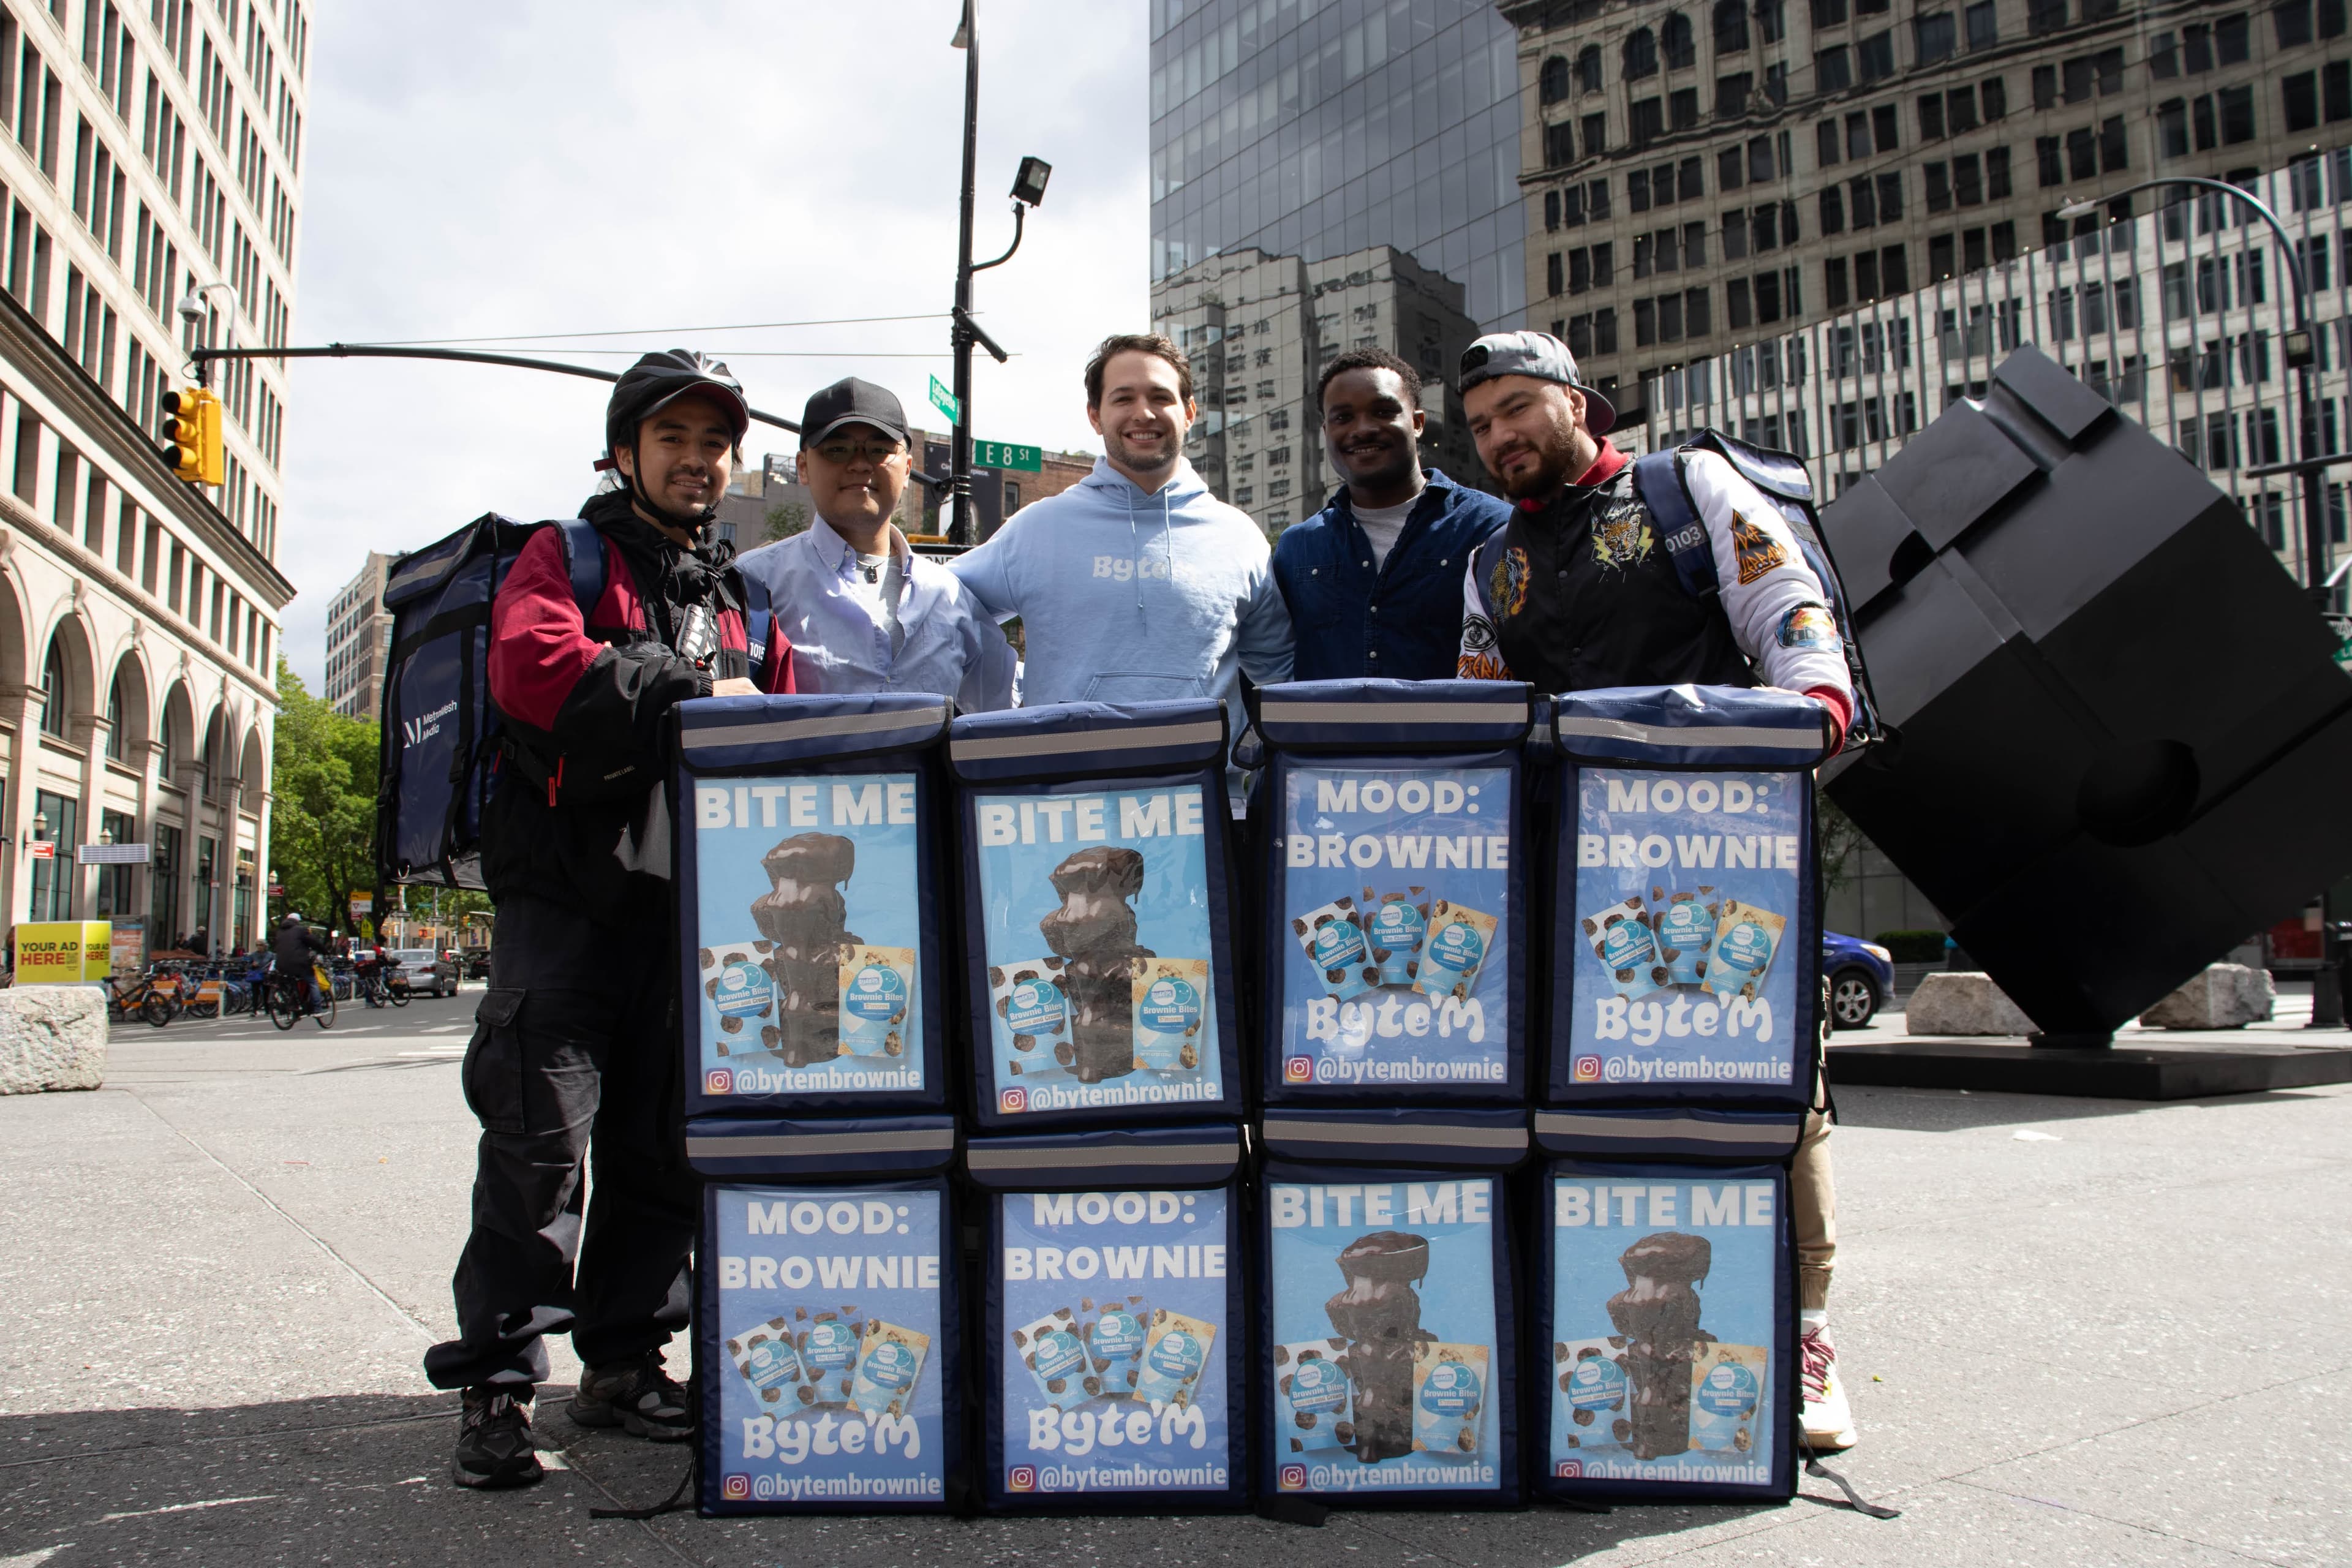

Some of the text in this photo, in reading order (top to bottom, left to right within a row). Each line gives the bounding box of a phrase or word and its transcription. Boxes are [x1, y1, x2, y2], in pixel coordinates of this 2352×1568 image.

[987, 445, 1029, 466] E 8 St
[1665, 526, 1701, 551] 0103
[750, 642, 765, 661] 1015
[696, 783, 916, 829] BITE ME
[1317, 780, 1480, 814] MOOD:
[1607, 780, 1768, 813] MOOD:
[980, 793, 1204, 846] BITE ME
[1287, 835, 1509, 869] BROWNIE
[1578, 835, 1798, 869] BROWNIE
[21, 941, 78, 952] YOUR AD
[21, 953, 65, 965] HERE
[86, 951, 104, 960] HERE
[718, 990, 750, 1001] Brownie
[1009, 1004, 1063, 1020] Brownie Bites
[736, 1066, 921, 1093] @bytembrownie
[1316, 1055, 1504, 1084] @bytembrownie
[1605, 1055, 1791, 1083] @bytembrownie
[1031, 1077, 1217, 1112] @bytembrownie
[747, 1202, 909, 1235] MOOD:
[1034, 1191, 1196, 1225] MOOD:
[1270, 1183, 1490, 1227] BITE ME
[1555, 1186, 1773, 1226] BITE ME
[719, 1256, 940, 1289] BROWNIE
[1005, 1245, 1226, 1280] BROWNIE
[1292, 1387, 1324, 1398] Brownie
[753, 1472, 940, 1500] @bytembrownie
[1039, 1463, 1226, 1492] @bytembrownie
[1310, 1460, 1493, 1491] @bytembrownie
